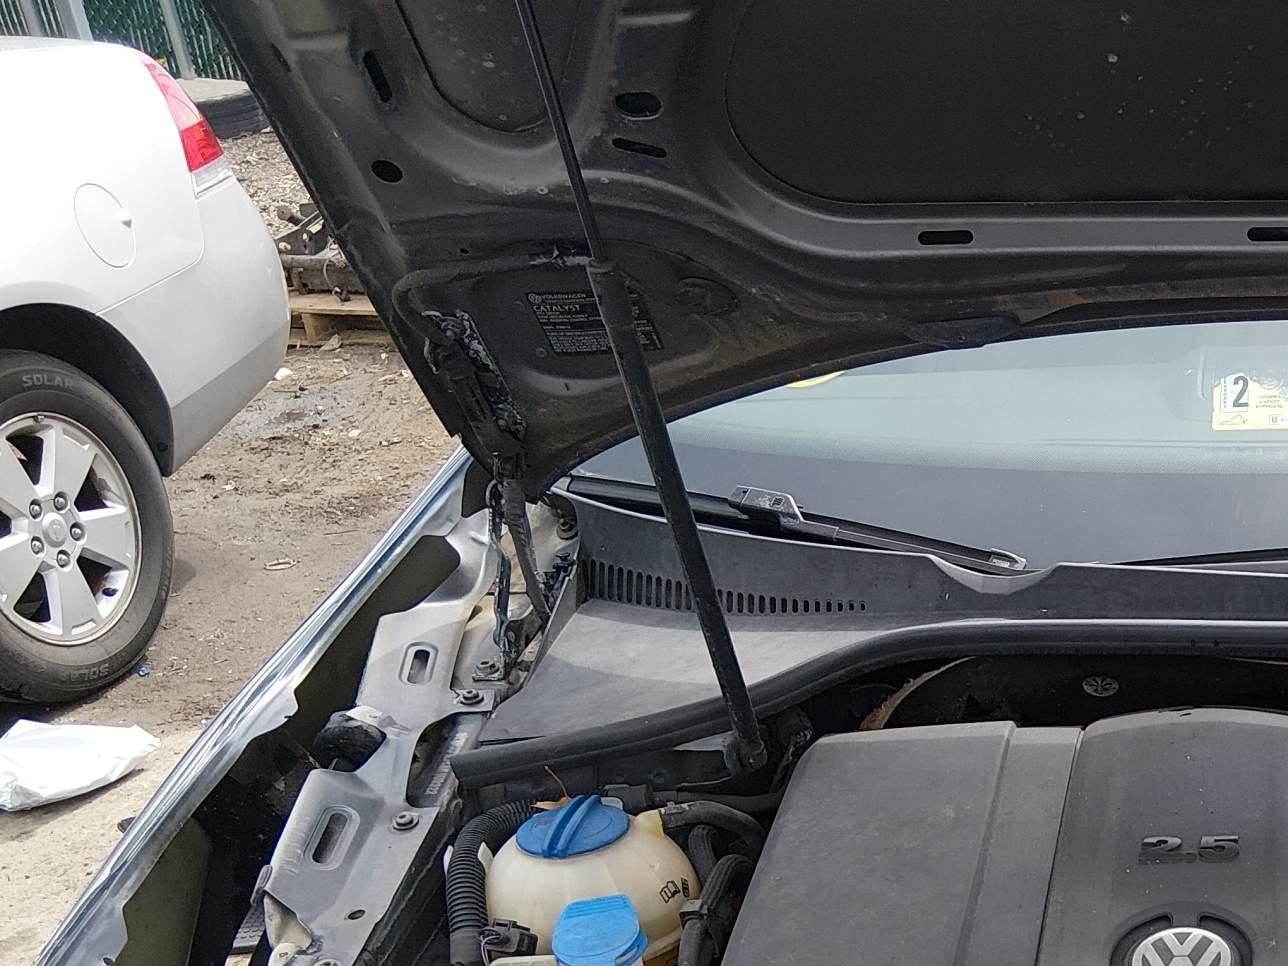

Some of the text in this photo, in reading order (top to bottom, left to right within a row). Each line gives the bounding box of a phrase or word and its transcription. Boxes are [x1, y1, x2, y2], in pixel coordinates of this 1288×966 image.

[533, 304, 581, 312] CATALYST
[22, 374, 75, 389] SOLAR
[1232, 375, 1249, 408] 2
[1139, 834, 1240, 865] 2.5
